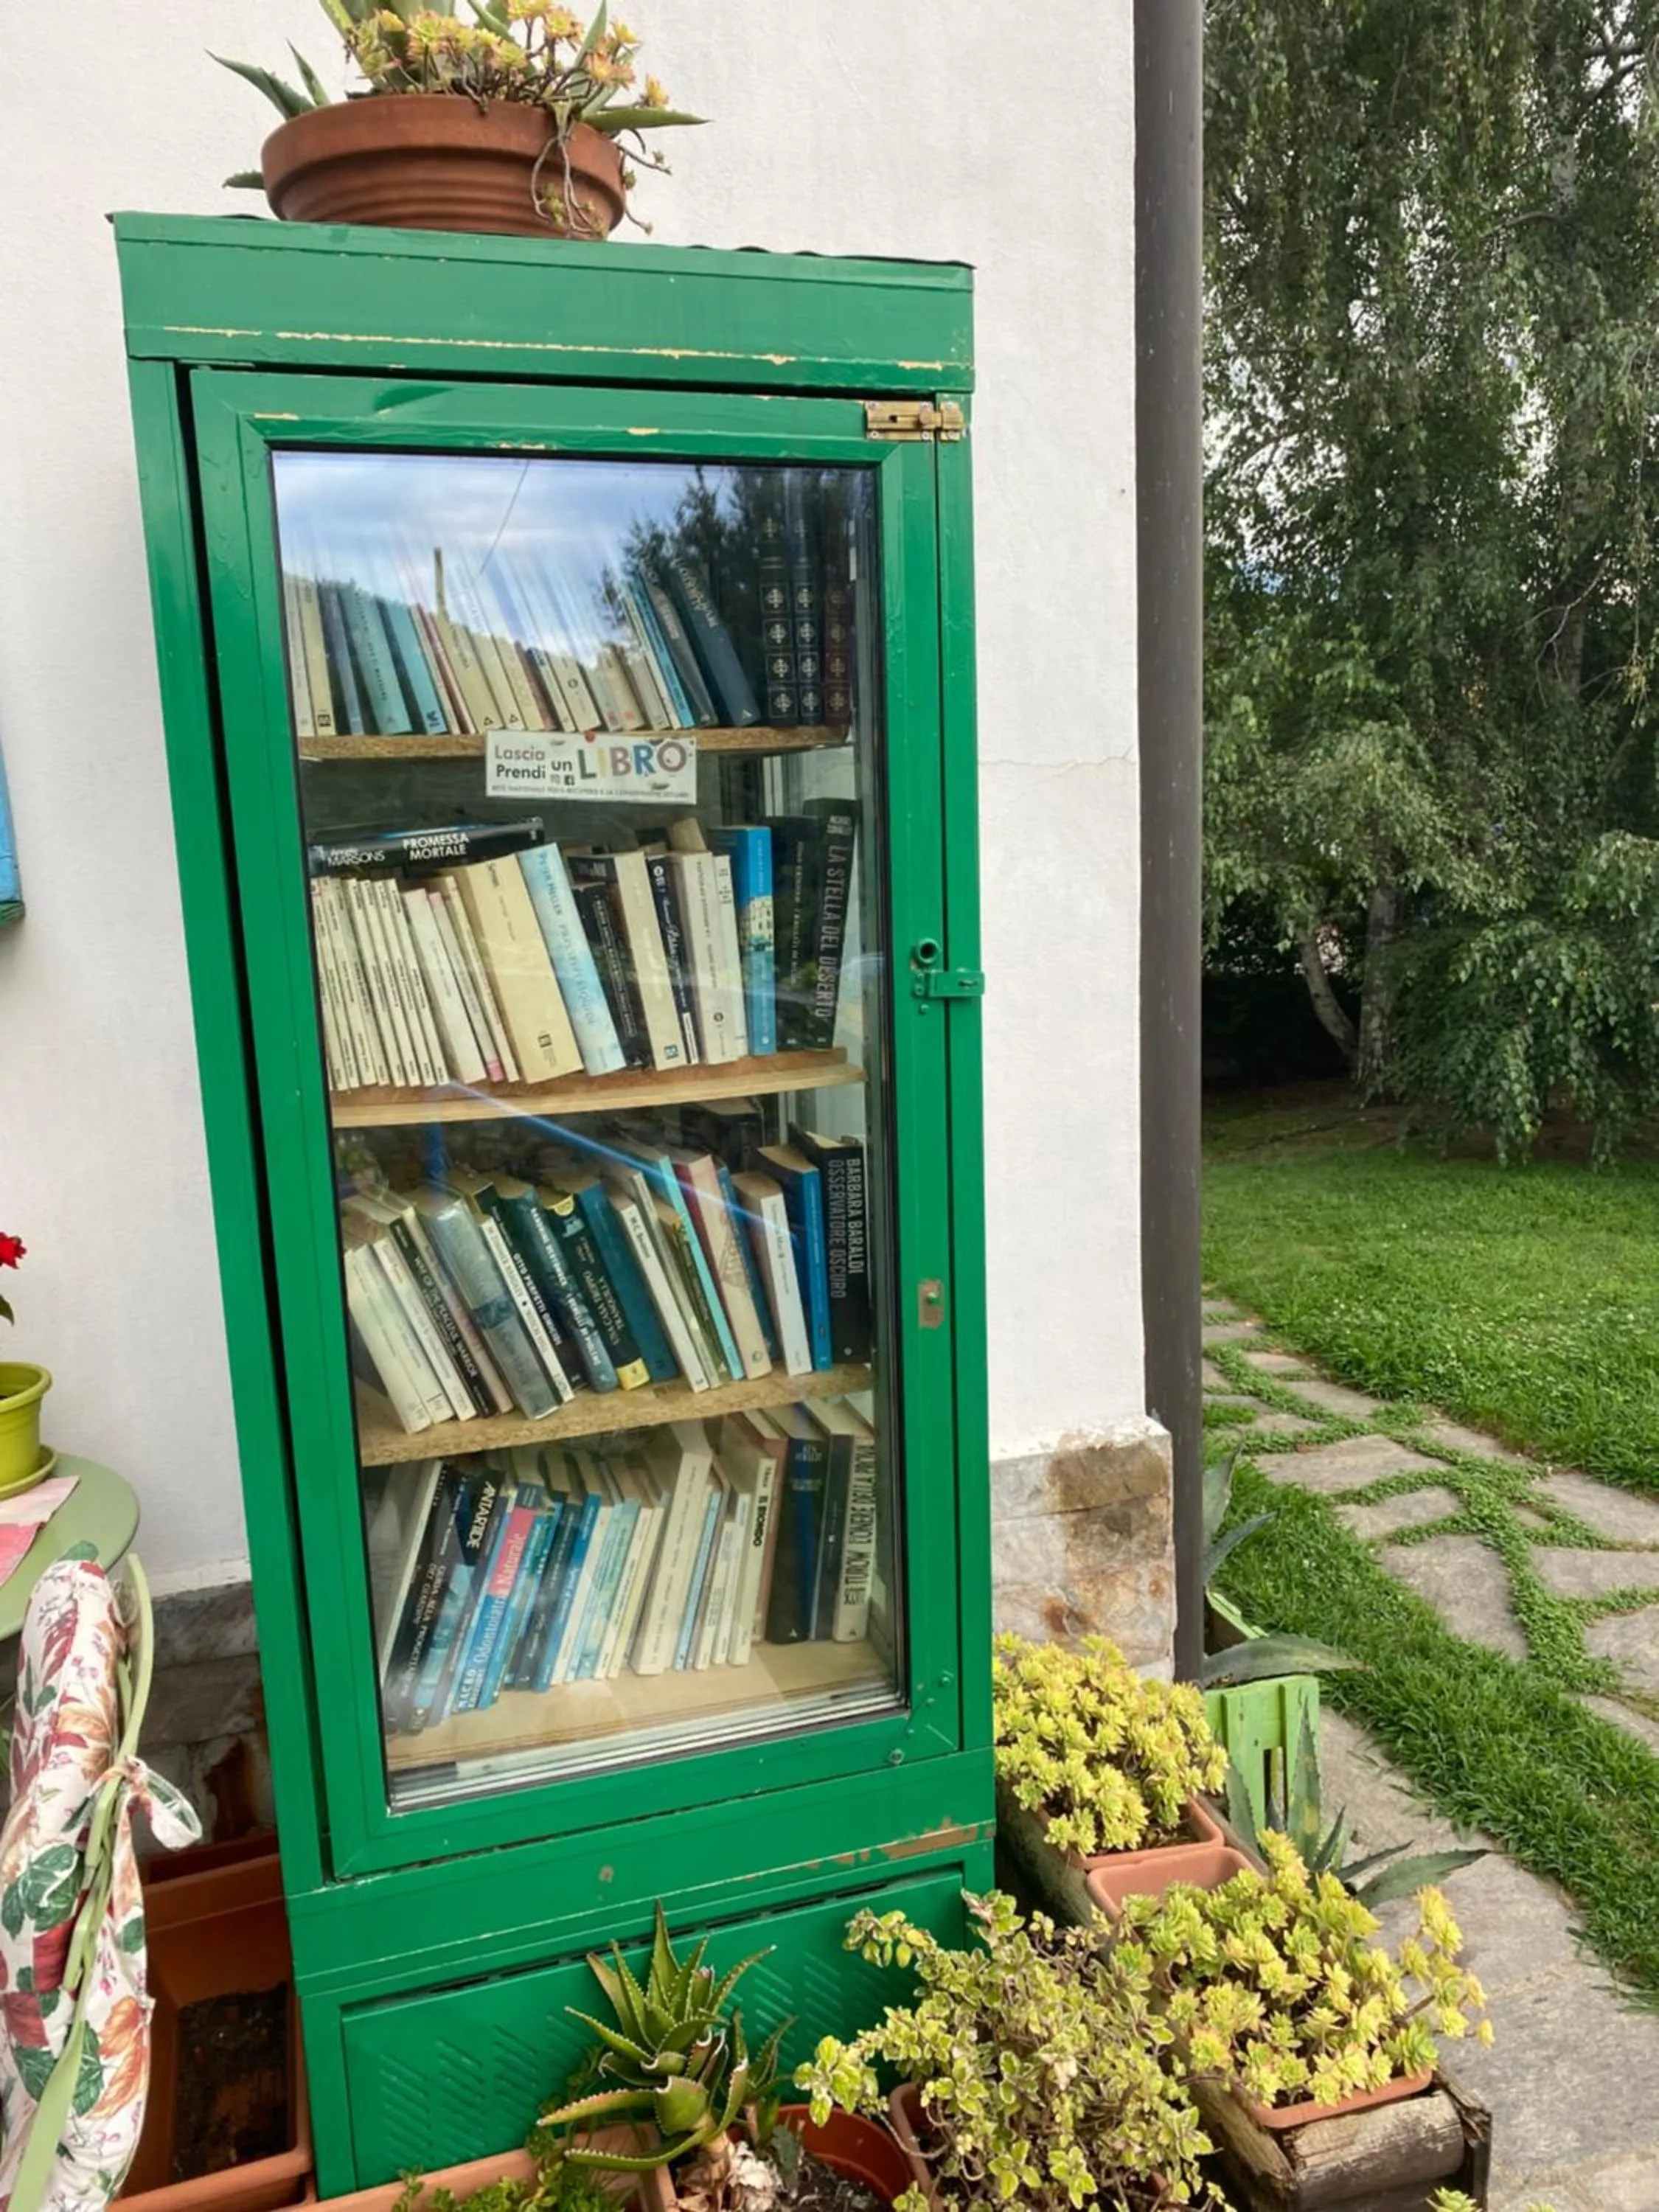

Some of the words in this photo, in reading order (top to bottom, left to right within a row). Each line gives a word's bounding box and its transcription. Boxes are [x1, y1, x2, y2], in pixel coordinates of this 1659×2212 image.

[494, 745, 545, 761] Lascia
[496, 764, 546, 779] Prendi
[551, 760, 573, 772] un
[577, 741, 687, 780] LIBRO
[327, 850, 385, 867] MARSONS
[403, 832, 469, 850] PROMESSA
[409, 844, 467, 861] MORTALE
[827, 844, 847, 863] LA
[821, 867, 845, 922] STELLA
[819, 925, 840, 952] DEL
[813, 956, 838, 1018] DESERTO
[827, 1159, 846, 1245] OSSERVATORE
[846, 1158, 862, 1217] BARBARA
[847, 1220, 864, 1273] BARALDI
[830, 1249, 846, 1298] OSCURO
[512, 1251, 529, 1276] OTTO
[522, 1273, 546, 1313] PERFETTI
[540, 1312, 563, 1346] OMICIDI
[596, 1301, 613, 1326] CASA
[466, 1481, 496, 1549] ANTARTIDE
[497, 1533, 525, 1587] Naturale
[844, 1549, 871, 1585] TUROW
